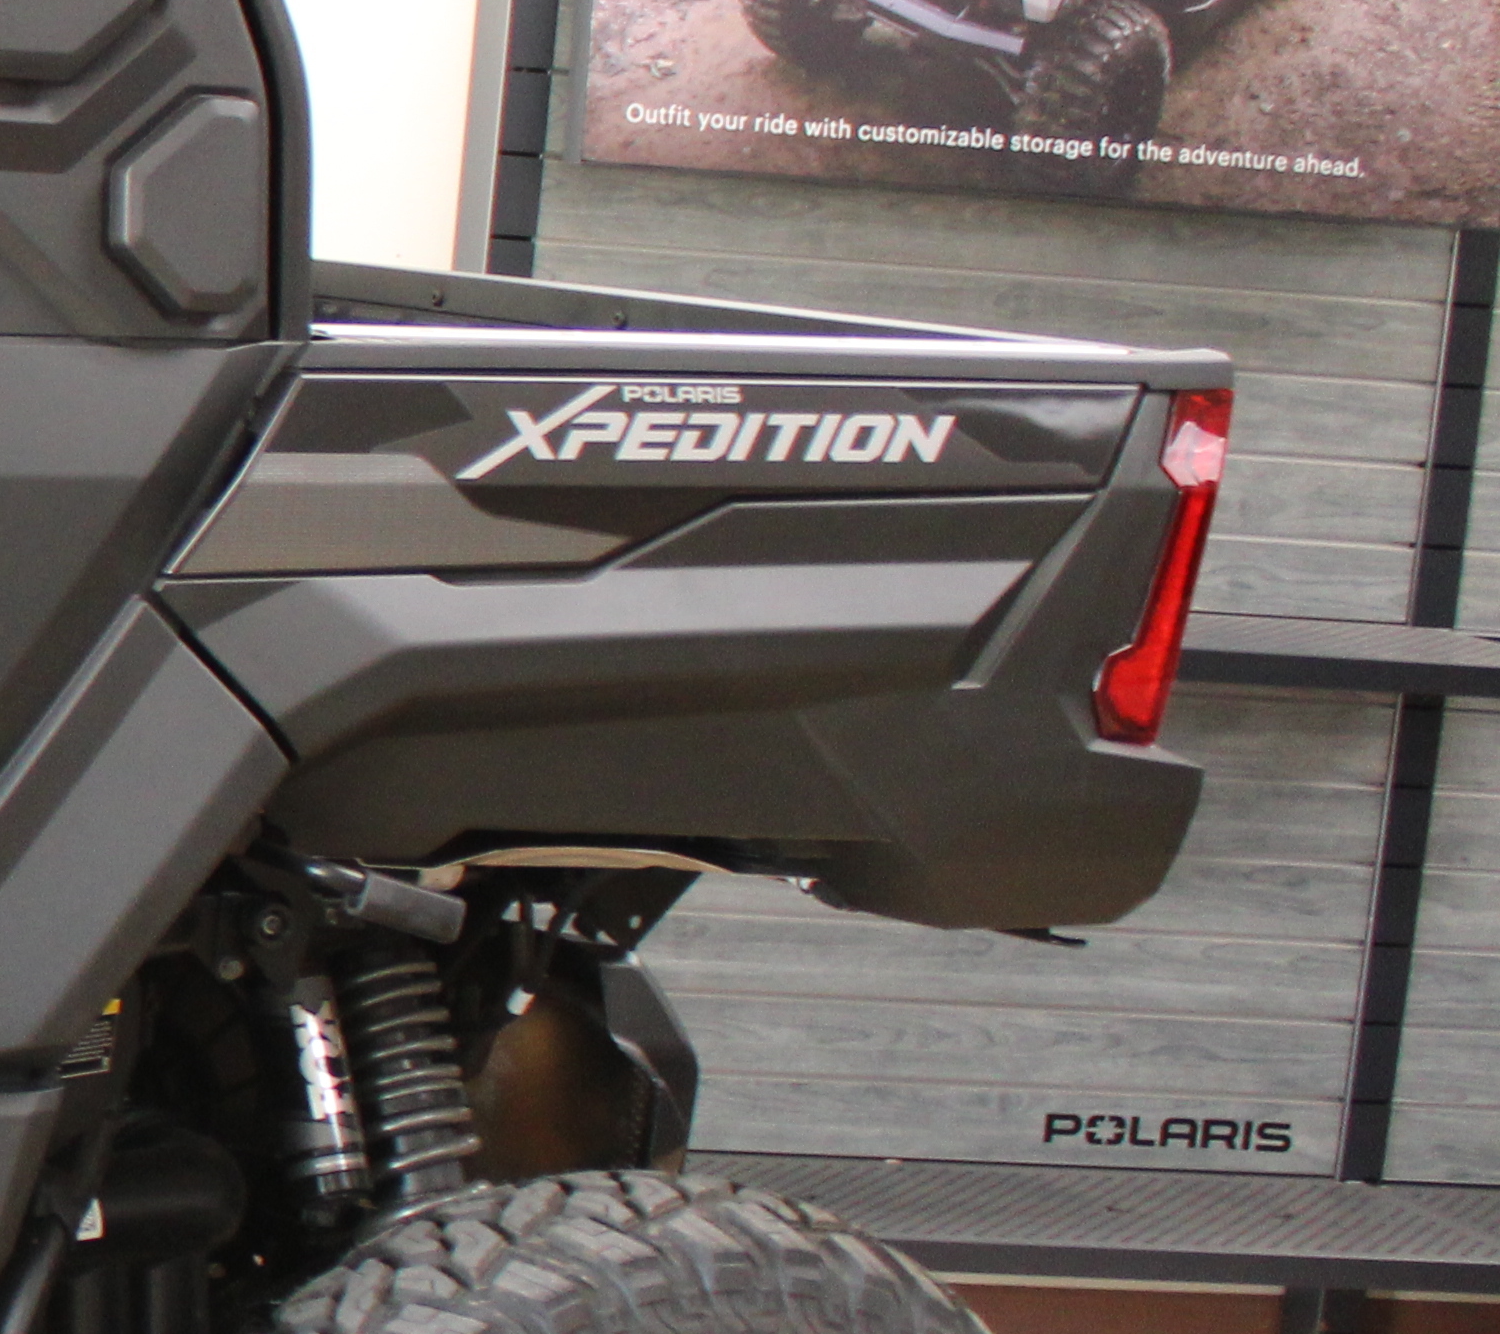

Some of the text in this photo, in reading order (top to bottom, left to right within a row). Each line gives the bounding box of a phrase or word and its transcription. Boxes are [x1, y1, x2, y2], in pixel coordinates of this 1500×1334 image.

[625, 102, 1366, 179] Outfit your ride with customizable storage for the adventure ahead.
[620, 384, 743, 405] POLARIS
[455, 385, 957, 480] XPEDITION
[1042, 1113, 1293, 1153] POLARIS
